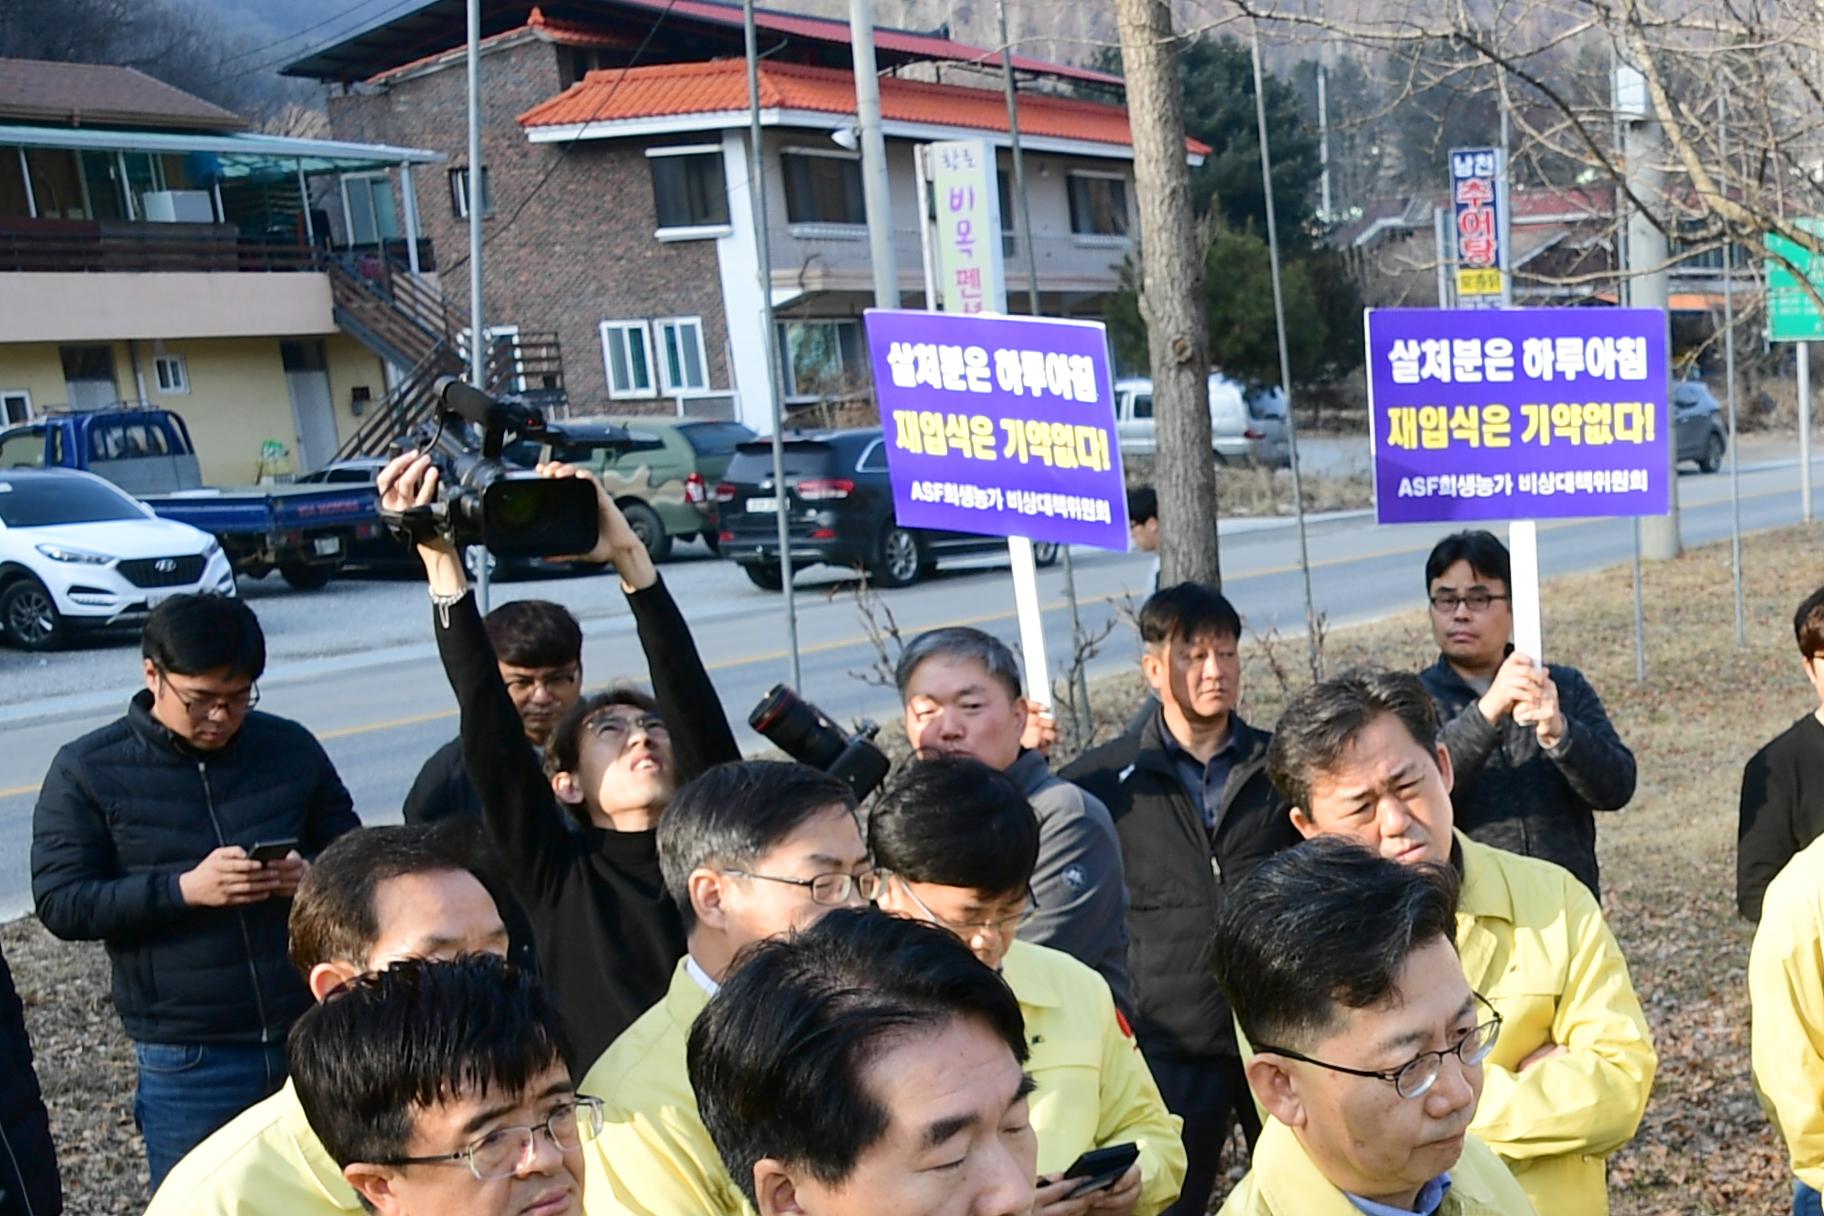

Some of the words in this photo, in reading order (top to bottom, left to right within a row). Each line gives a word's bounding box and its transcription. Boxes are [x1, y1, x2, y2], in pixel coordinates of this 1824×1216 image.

[1456, 178, 1497, 268] 추어탕
[887, 342, 992, 393] 살처분은
[994, 348, 1098, 403] 하루아침
[1387, 337, 1515, 384] 살처분은
[1522, 336, 1648, 382] 하루아침
[893, 410, 997, 460] 재입식은
[1000, 418, 1111, 471] 기약없다!
[1387, 404, 1512, 450] 재입식은
[1520, 402, 1656, 447] 기약없다!
[911, 480, 1004, 511] ASF희생농가
[1006, 489, 1111, 525] 비상대책위원회
[1398, 472, 1513, 498] ASF희생농가
[1518, 469, 1648, 496] 비상대책위원회
